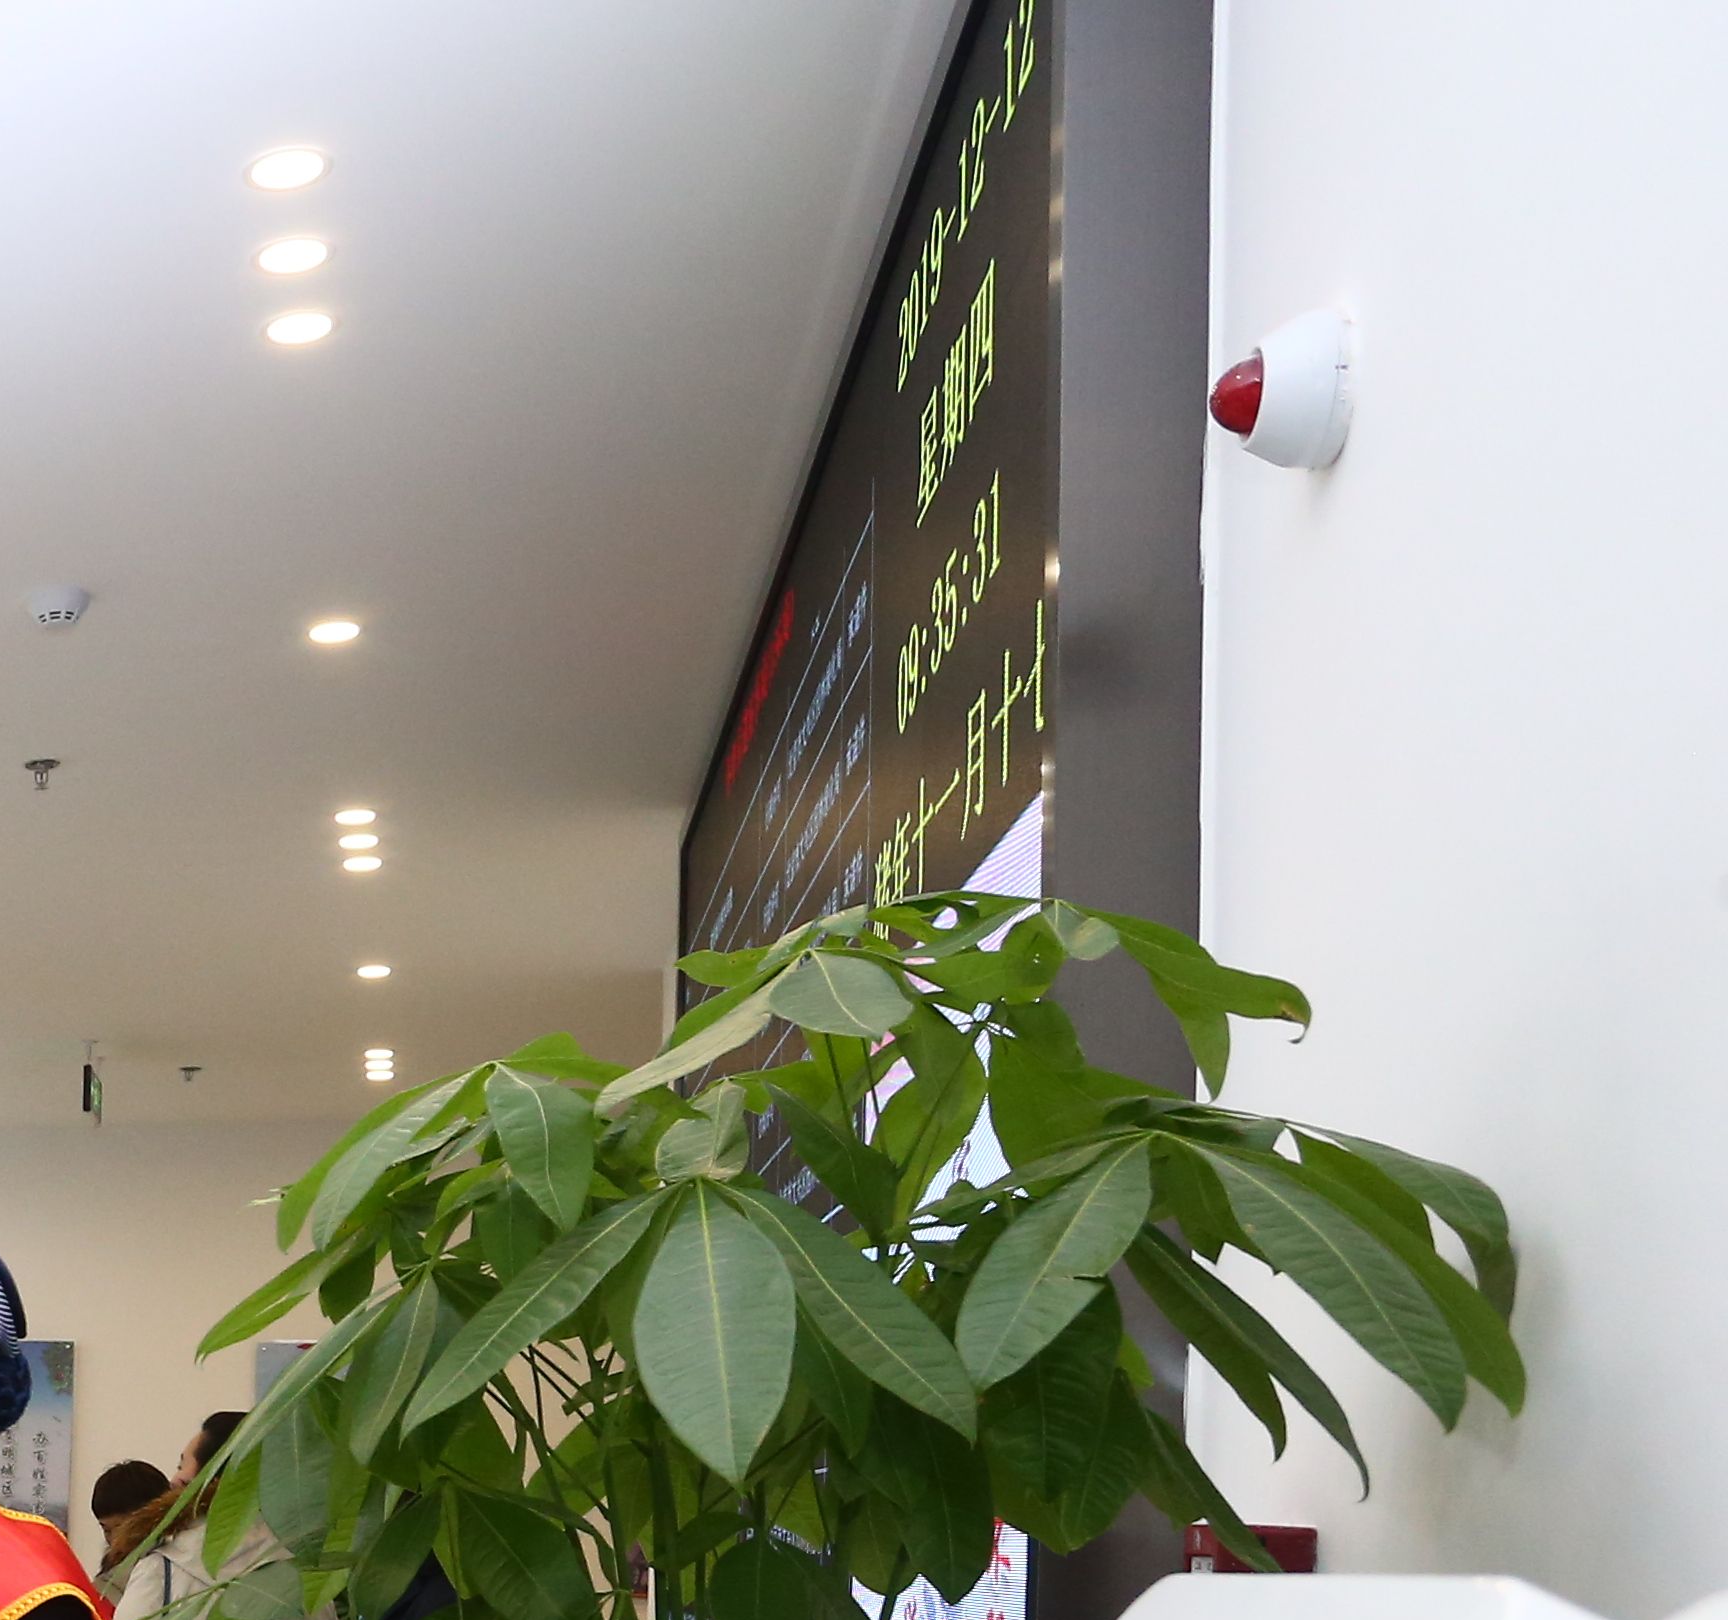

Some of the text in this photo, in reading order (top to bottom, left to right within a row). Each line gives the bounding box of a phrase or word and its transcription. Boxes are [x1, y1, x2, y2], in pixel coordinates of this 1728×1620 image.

[897, 0, 1034, 393] 2019-12-12
[917, 258, 995, 527] 星期四
[897, 467, 1000, 734] 09:35:31
